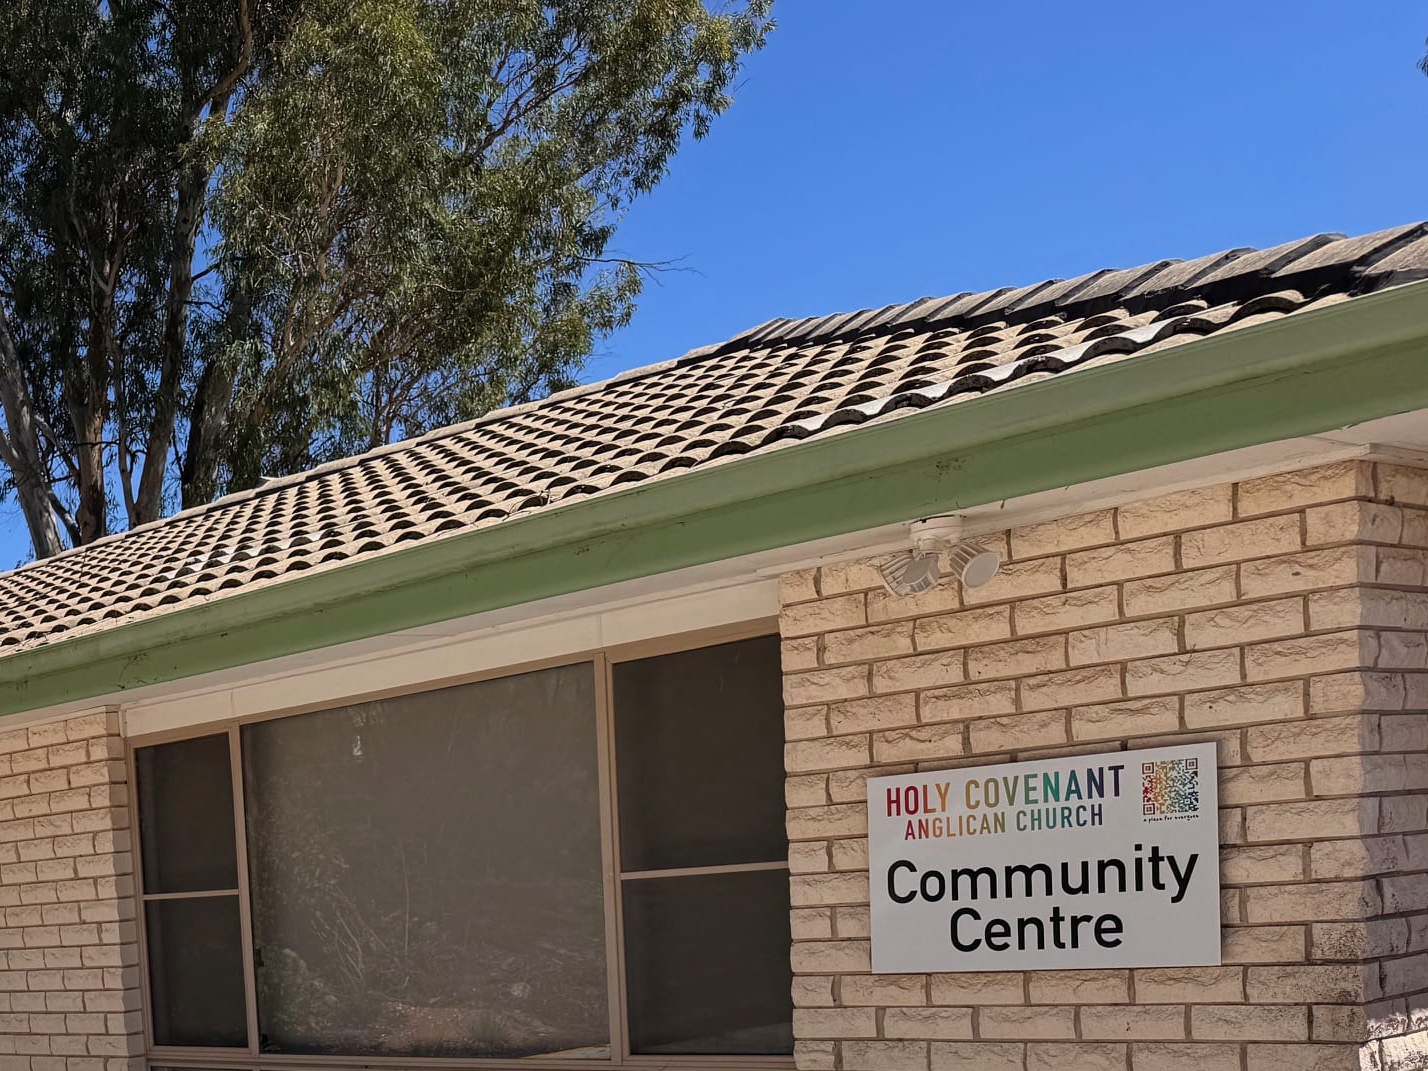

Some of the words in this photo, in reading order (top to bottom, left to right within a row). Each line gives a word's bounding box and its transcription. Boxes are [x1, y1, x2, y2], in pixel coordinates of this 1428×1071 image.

[886, 782, 951, 817] HOLY
[965, 764, 1125, 809] COVENANT
[904, 811, 1006, 841] ANGLICAN
[1016, 803, 1103, 832] CHURCH
[887, 843, 1199, 904] Community
[950, 906, 1124, 953] Centre
